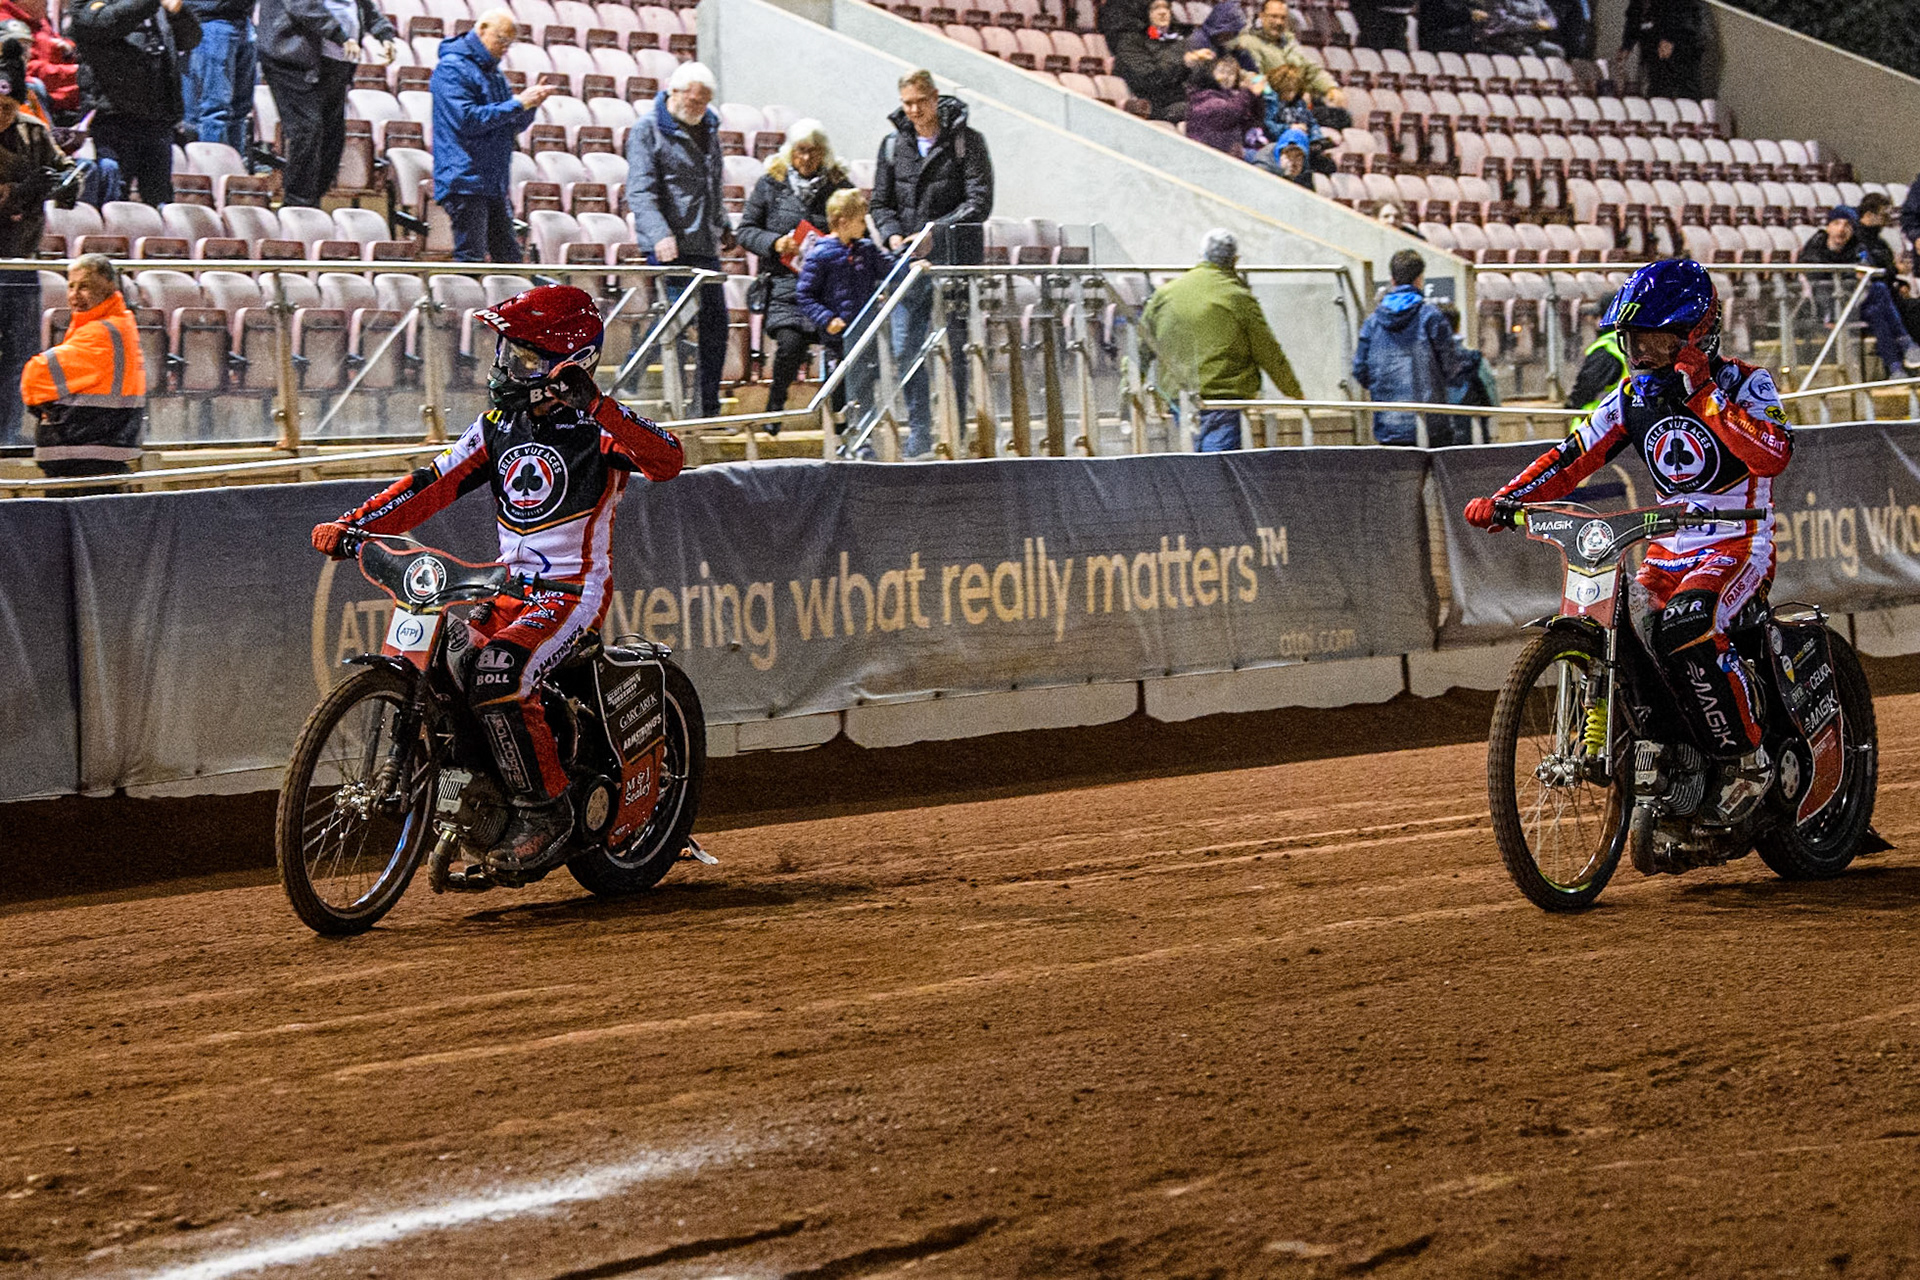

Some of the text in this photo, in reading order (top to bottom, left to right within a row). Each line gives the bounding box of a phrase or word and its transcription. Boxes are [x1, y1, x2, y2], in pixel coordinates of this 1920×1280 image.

[1647, 421, 1712, 452] BELLE VUE ACES
[498, 450, 521, 476] BELLE
[543, 450, 563, 474] ACES
[1536, 520, 1574, 532] MAGIK
[789, 550, 931, 640] what
[941, 537, 1074, 643] really
[1663, 600, 1703, 621] DVR
[400, 627, 419, 638] ATPI
[475, 674, 510, 686] BOLL
[1687, 666, 1738, 749] MAGIK
[1805, 689, 1839, 731] MAGIK
